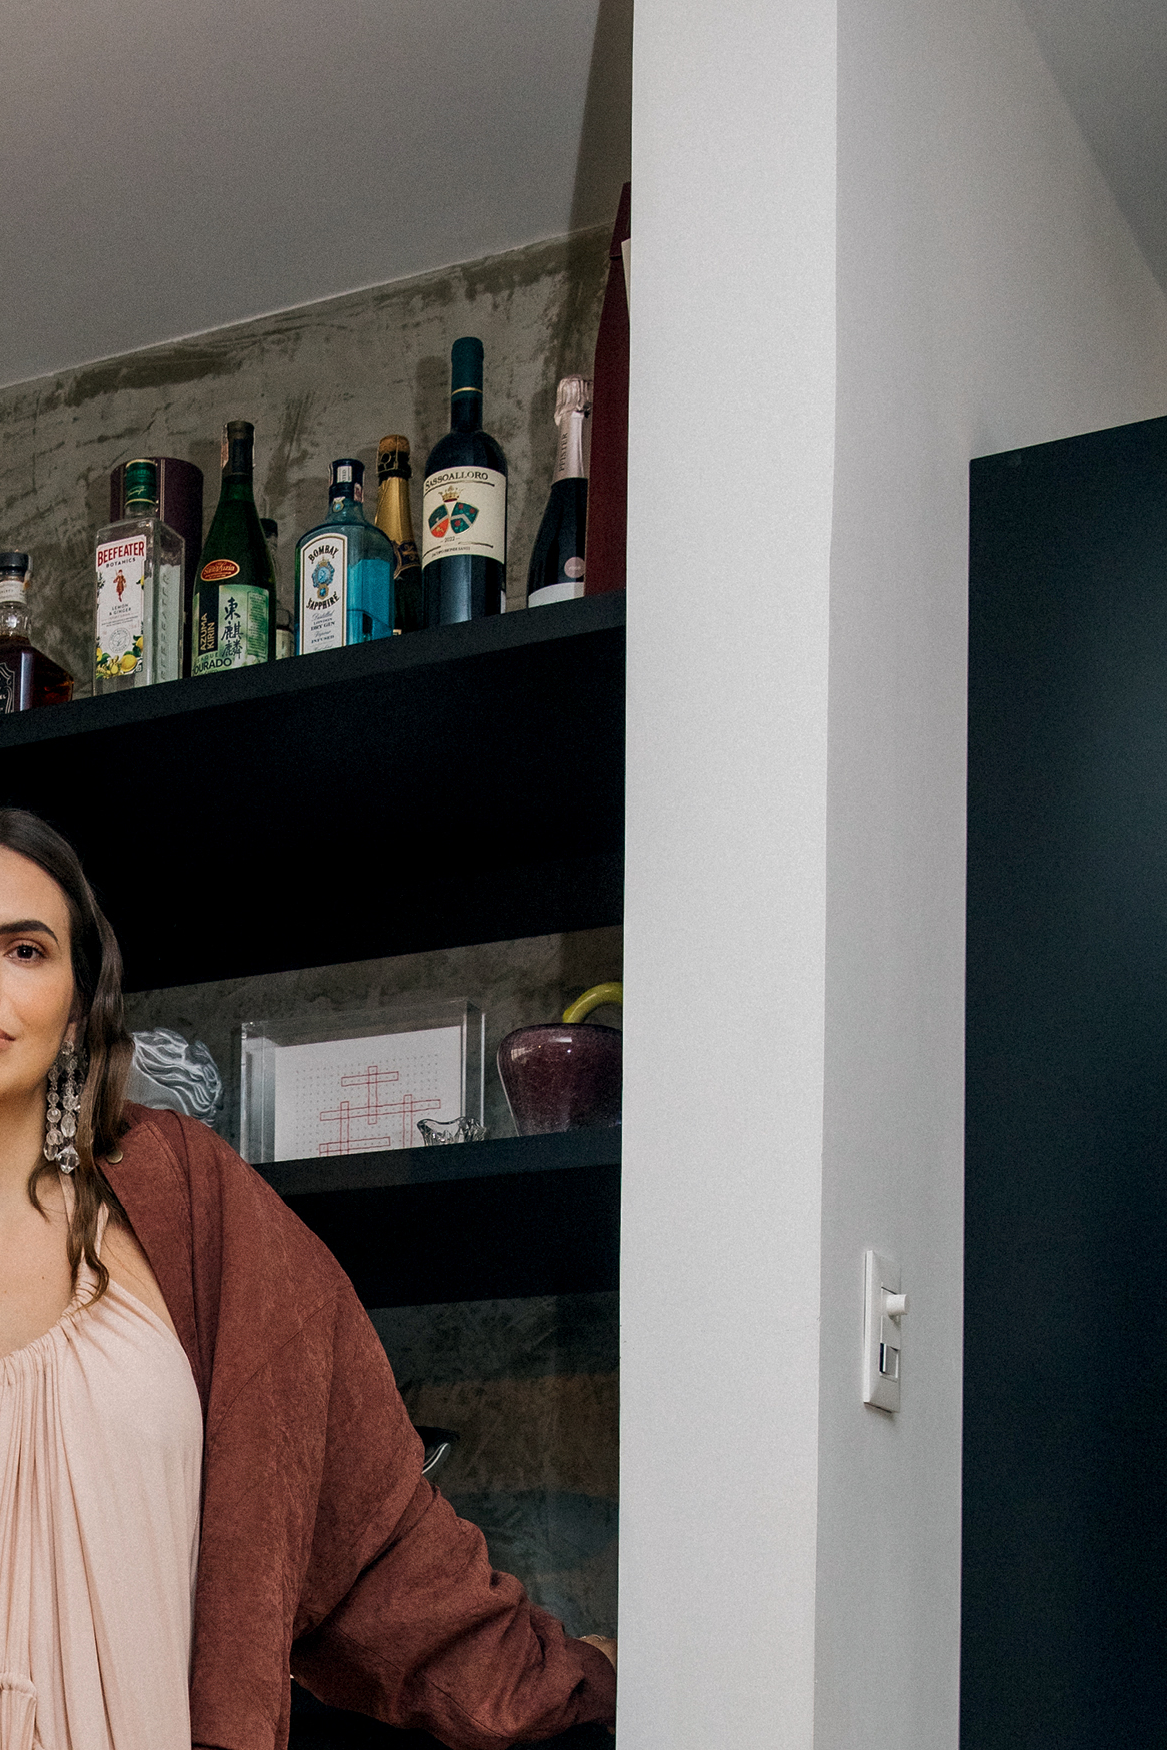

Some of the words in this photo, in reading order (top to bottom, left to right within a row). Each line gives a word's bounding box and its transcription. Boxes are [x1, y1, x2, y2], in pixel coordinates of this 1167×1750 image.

[558, 432, 569, 472] PFISTER
[425, 471, 489, 489] SASSOALLORO
[97, 541, 145, 568] BEEFEATER
[106, 557, 136, 569] BOTANICS
[307, 544, 339, 564] BOMBAY
[112, 603, 129, 611] LEMON
[113, 607, 132, 615] GINGER
[306, 591, 341, 611] SAPPHIRE
[200, 612, 209, 651] AZUMA
[207, 621, 216, 650] KIRIN
[192, 657, 232, 675] OURADO
